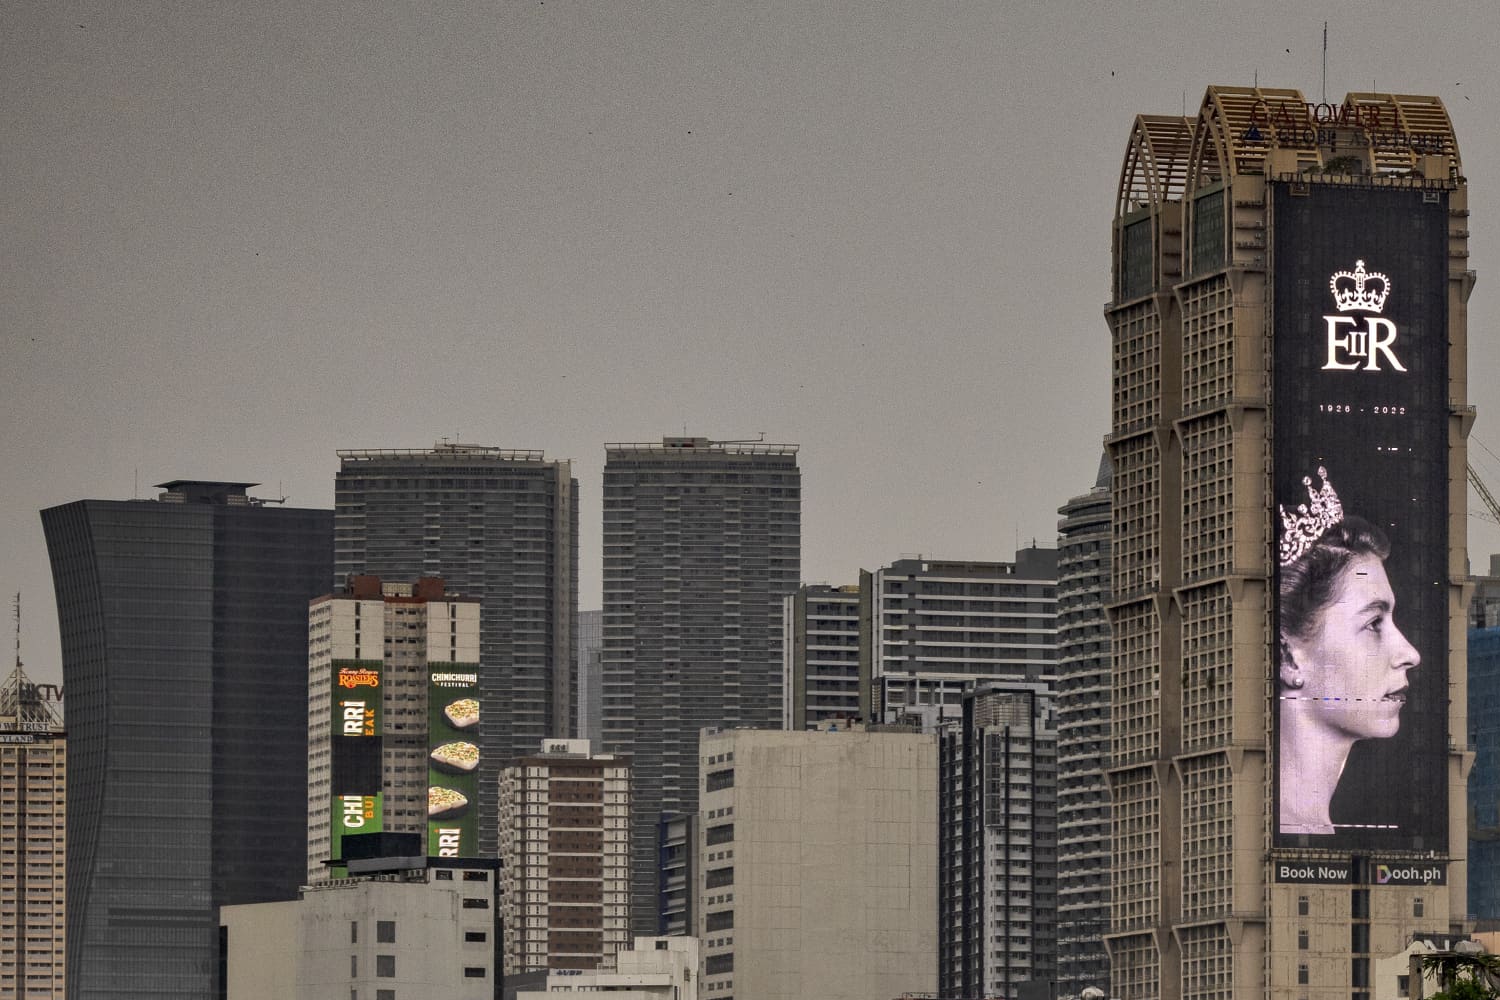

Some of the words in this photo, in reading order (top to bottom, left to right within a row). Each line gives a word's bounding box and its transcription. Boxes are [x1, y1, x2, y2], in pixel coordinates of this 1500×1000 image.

[1320, 404, 1351, 413] 1926
[1374, 406, 1406, 415] 2022
[339, 674, 379, 687] ROASTERS
[1280, 866, 1315, 879] Book
[1318, 867, 1348, 879] Now
